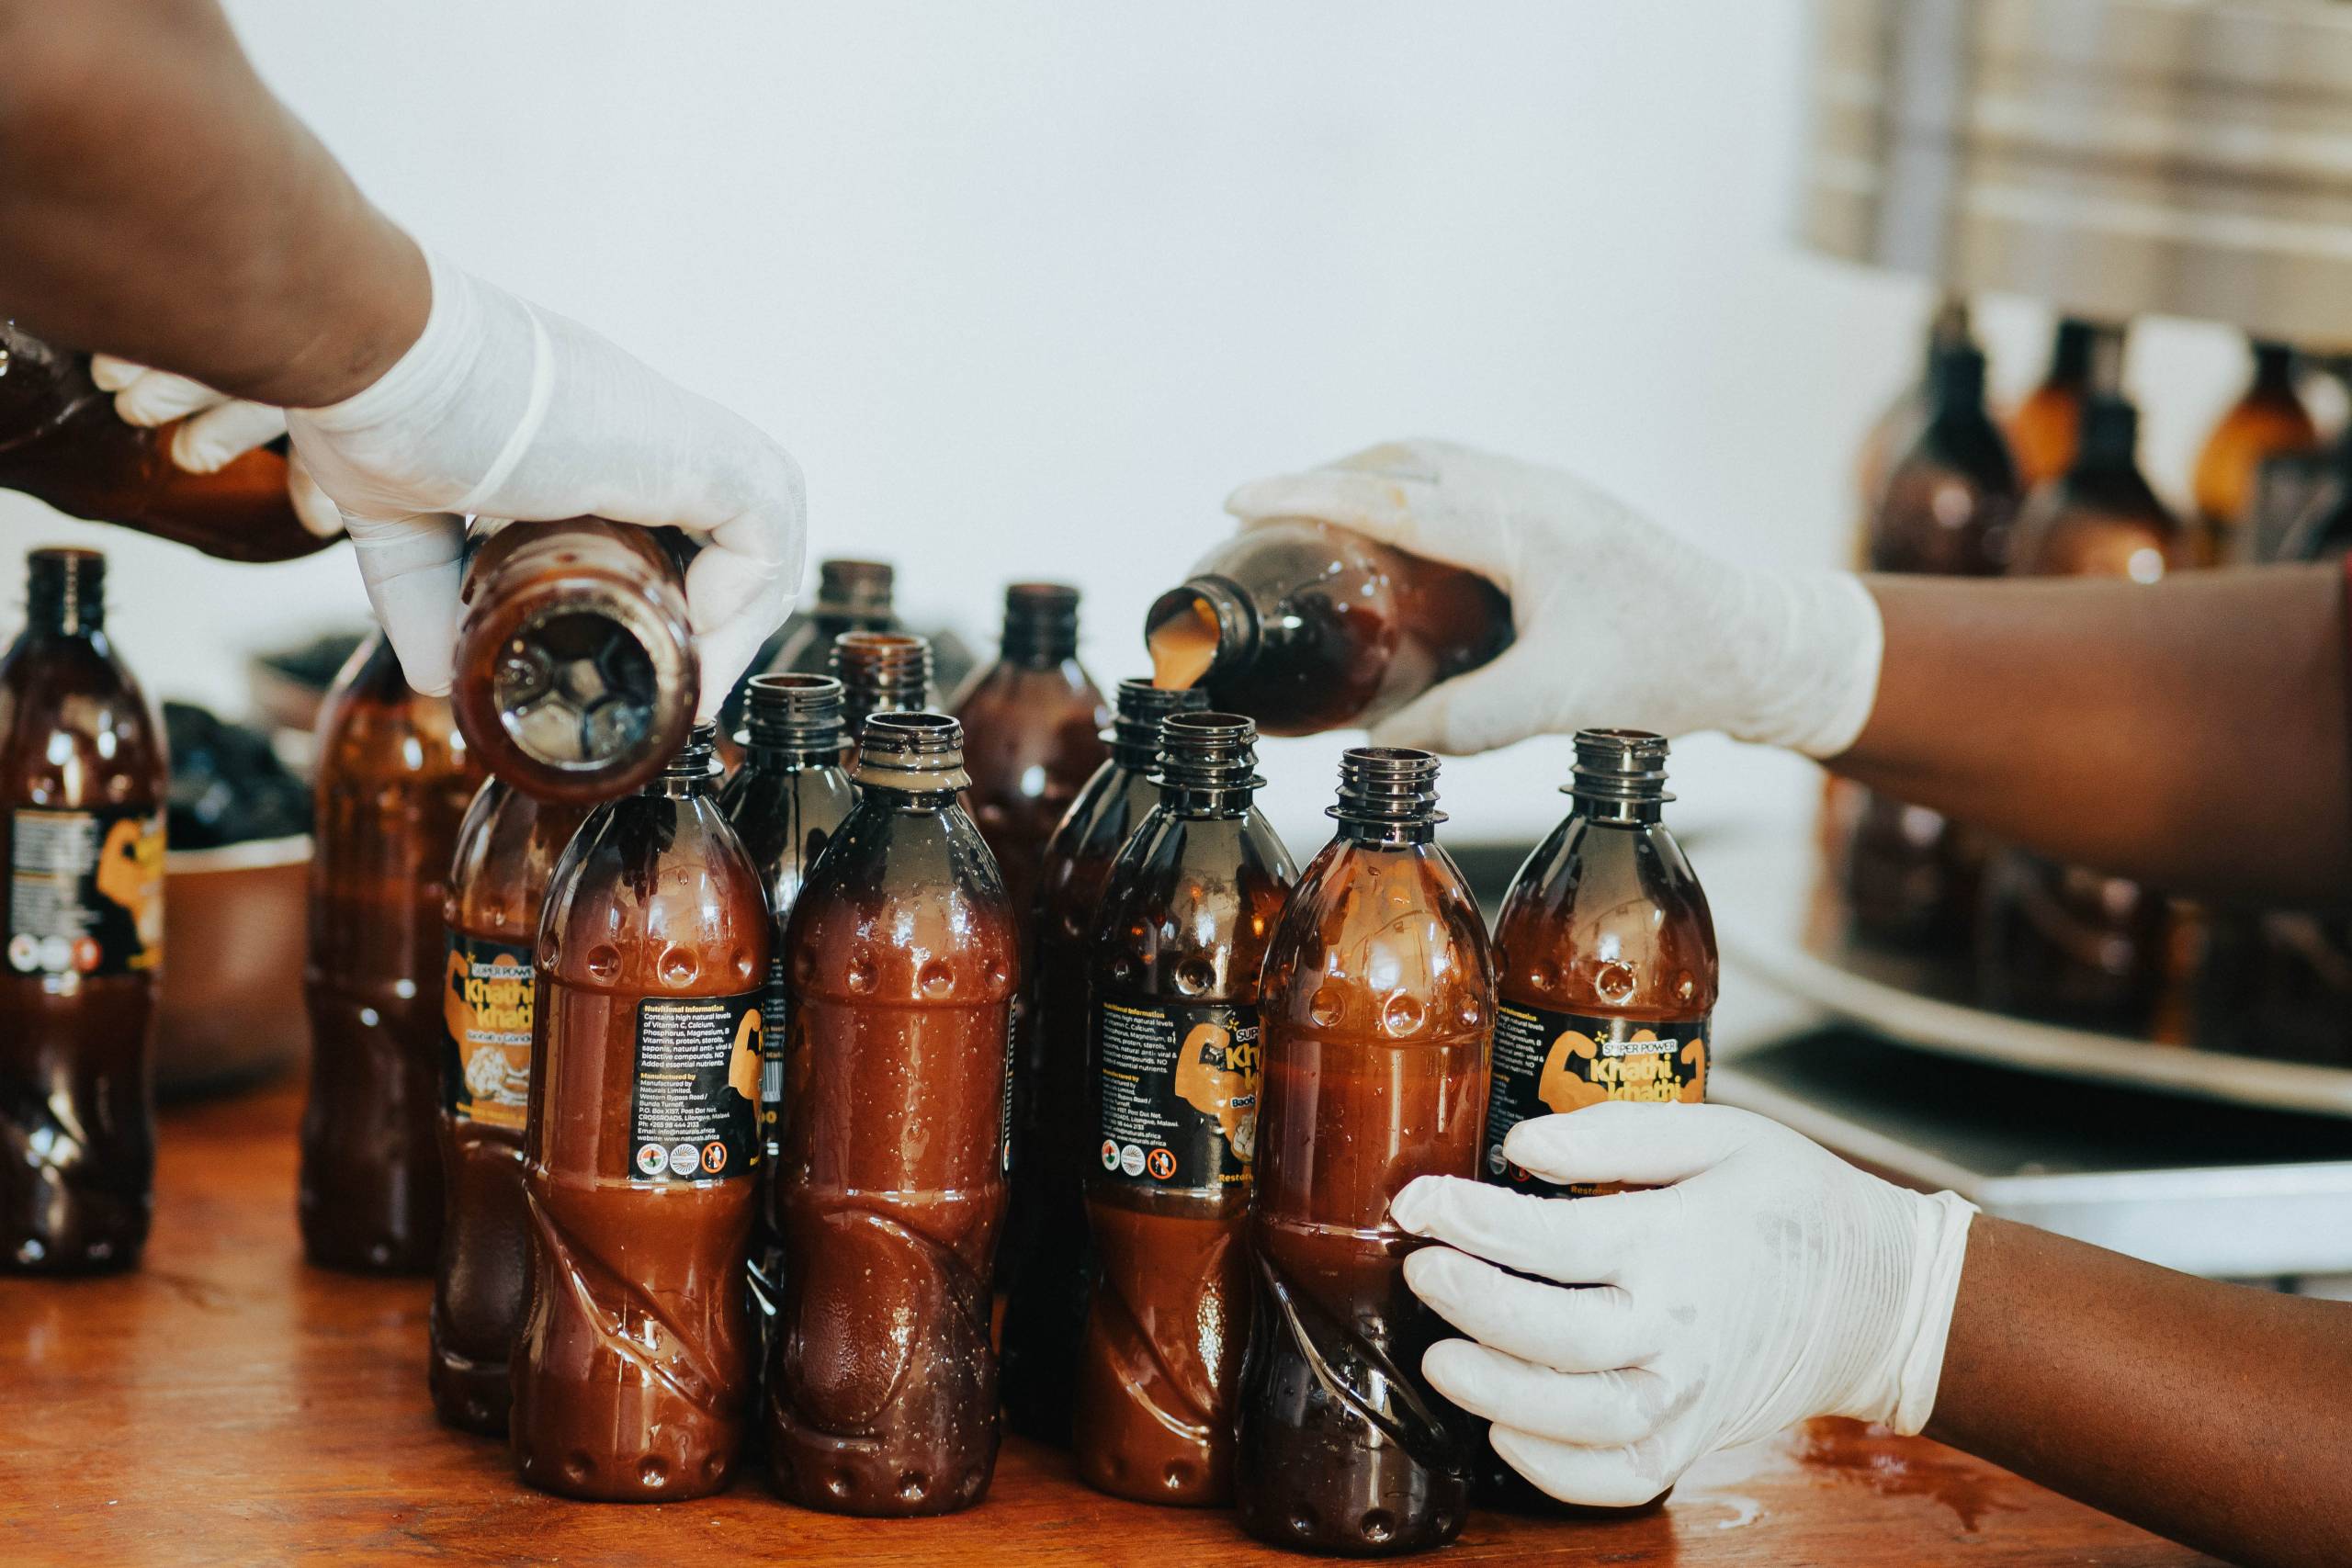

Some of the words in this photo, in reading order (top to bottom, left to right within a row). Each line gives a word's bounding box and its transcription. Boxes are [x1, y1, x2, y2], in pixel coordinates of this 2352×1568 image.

[685, 1004, 724, 1012] Information
[1128, 1008, 1165, 1019] Information
[1134, 1017, 1155, 1025] natural
[1156, 1019, 1174, 1027] levels
[1528, 1021, 1544, 1031] levels
[643, 1029, 685, 1037] Phosphorus,
[686, 1028, 724, 1037] Magnesium,
[1131, 1024, 1156, 1033] Calcium,
[676, 1037, 700, 1045] protein,
[1130, 1032, 1166, 1043] Magnesium,
[1122, 1039, 1142, 1047] protein,
[1641, 1041, 1676, 1054] POWER
[1121, 1046, 1139, 1055] natural
[642, 1052, 673, 1060] bioactive
[1116, 1060, 1137, 1069] essential
[1139, 1065, 1168, 1073] nutrients.
[1590, 1053, 1672, 1082] Khathi
[1608, 1075, 1681, 1102] khathi
[1131, 1116, 1156, 1126] Lilongwe,
